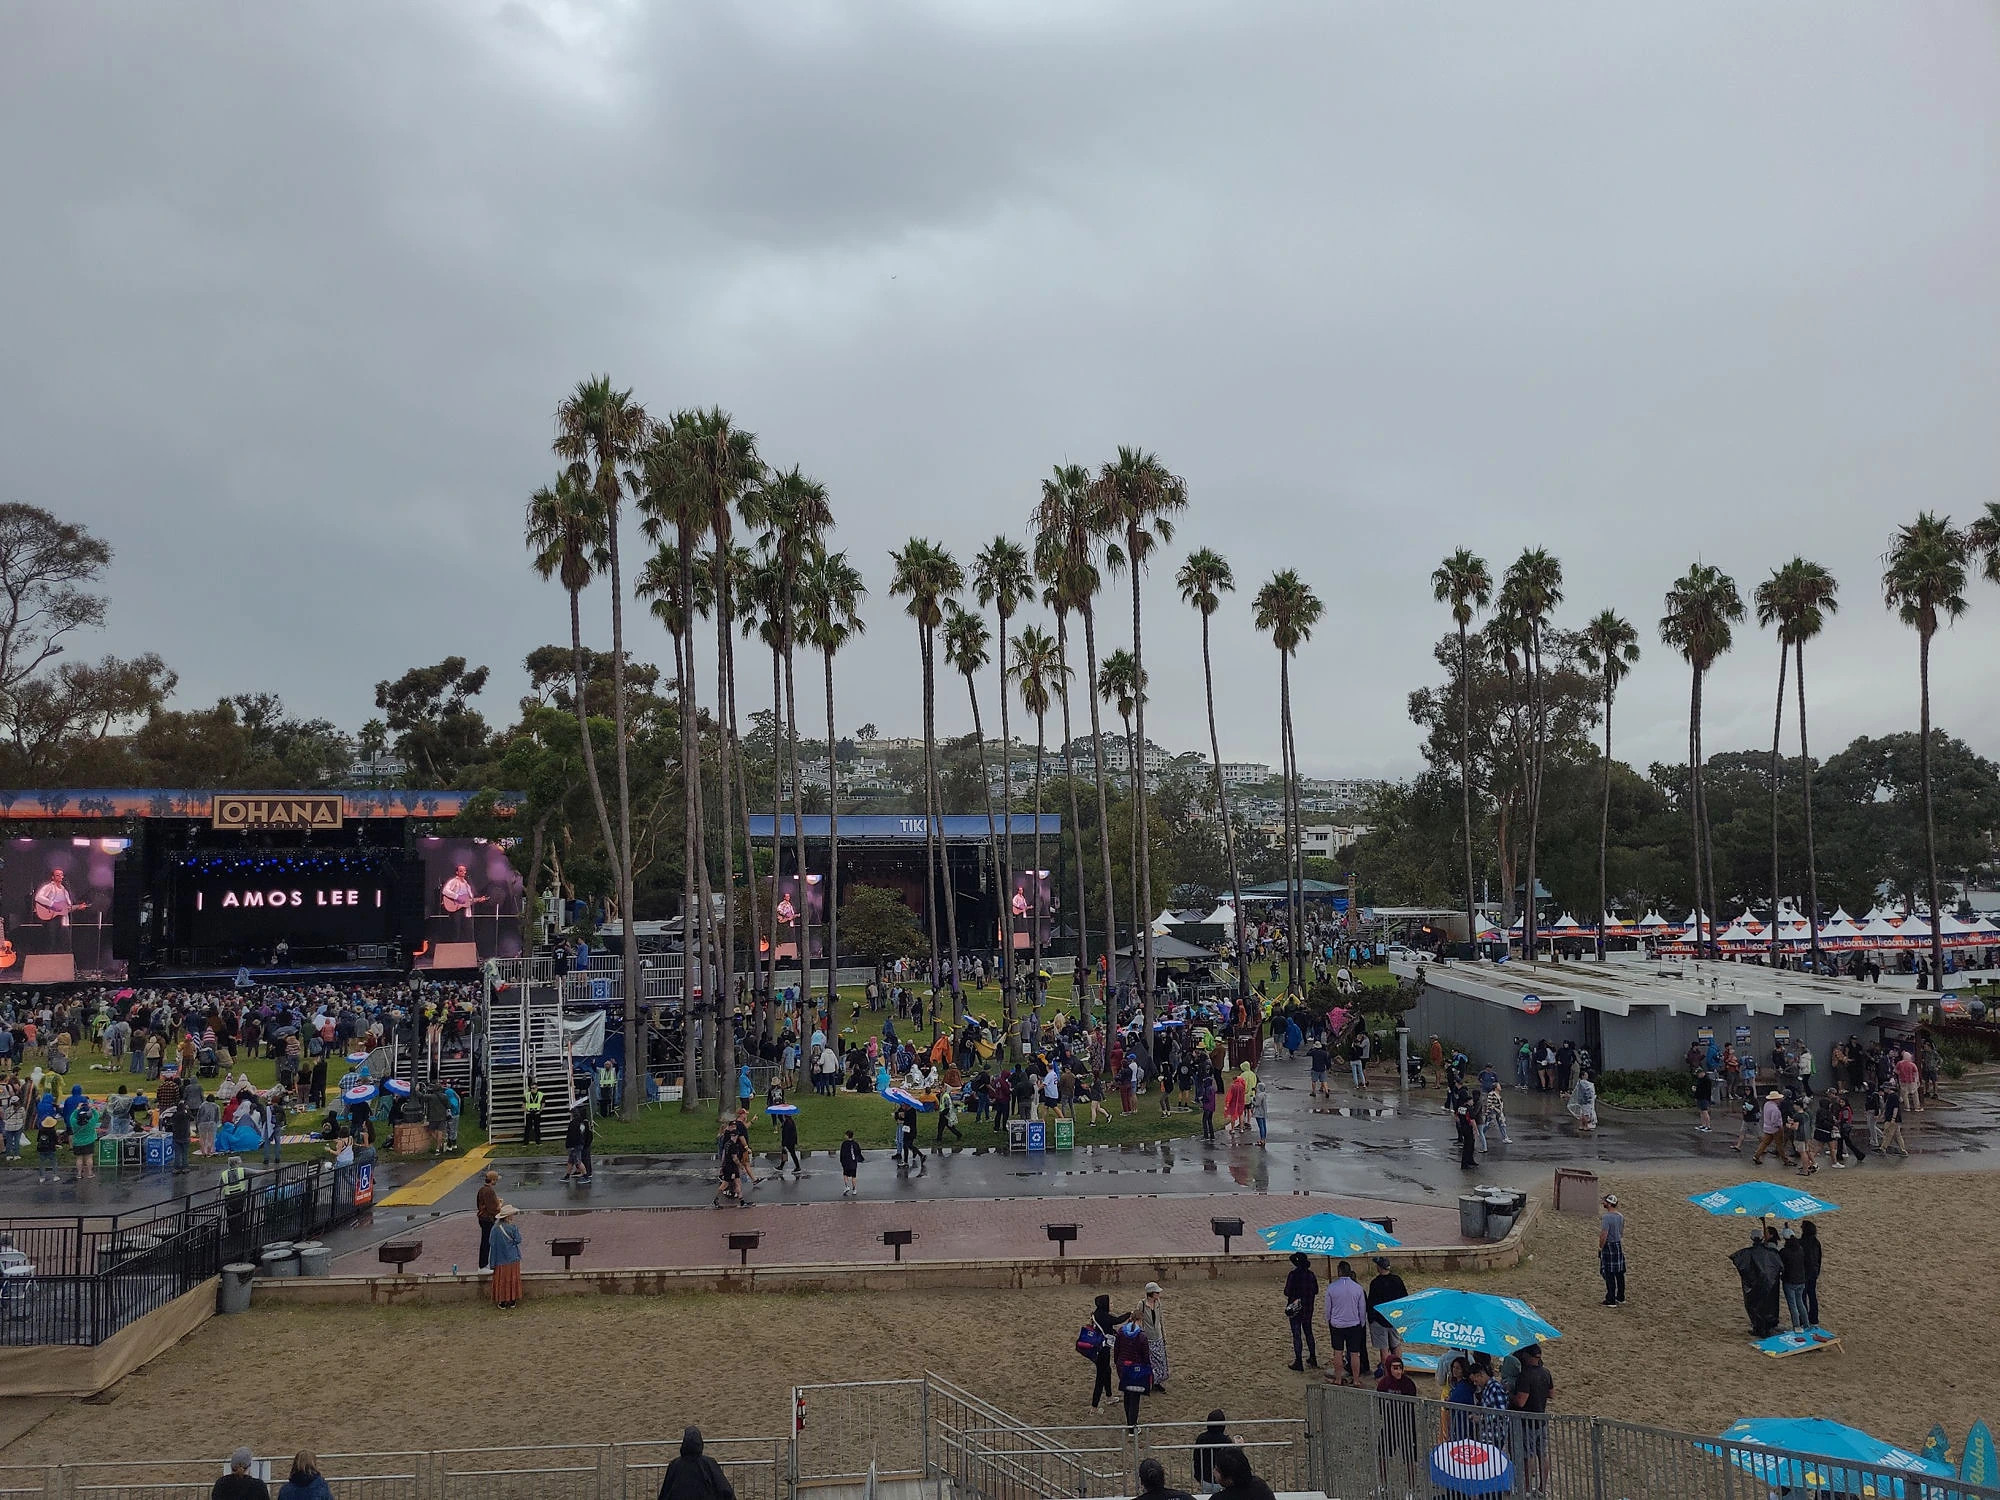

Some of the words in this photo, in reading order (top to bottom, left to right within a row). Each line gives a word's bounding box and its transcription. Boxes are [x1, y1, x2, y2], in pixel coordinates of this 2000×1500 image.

[222, 801, 334, 823] OHANA
[900, 819, 928, 832] TIKI
[222, 891, 303, 907] AMOS
[317, 890, 359, 905] LEE
[1662, 944, 1695, 952] COCKTAILS
[1843, 939, 1873, 947] COCKTAILS
[1294, 1233, 1335, 1245] KONA
[1432, 1319, 1486, 1337] KONA
[1430, 1330, 1453, 1339] BIG
[1453, 1333, 1487, 1345] WAVE
